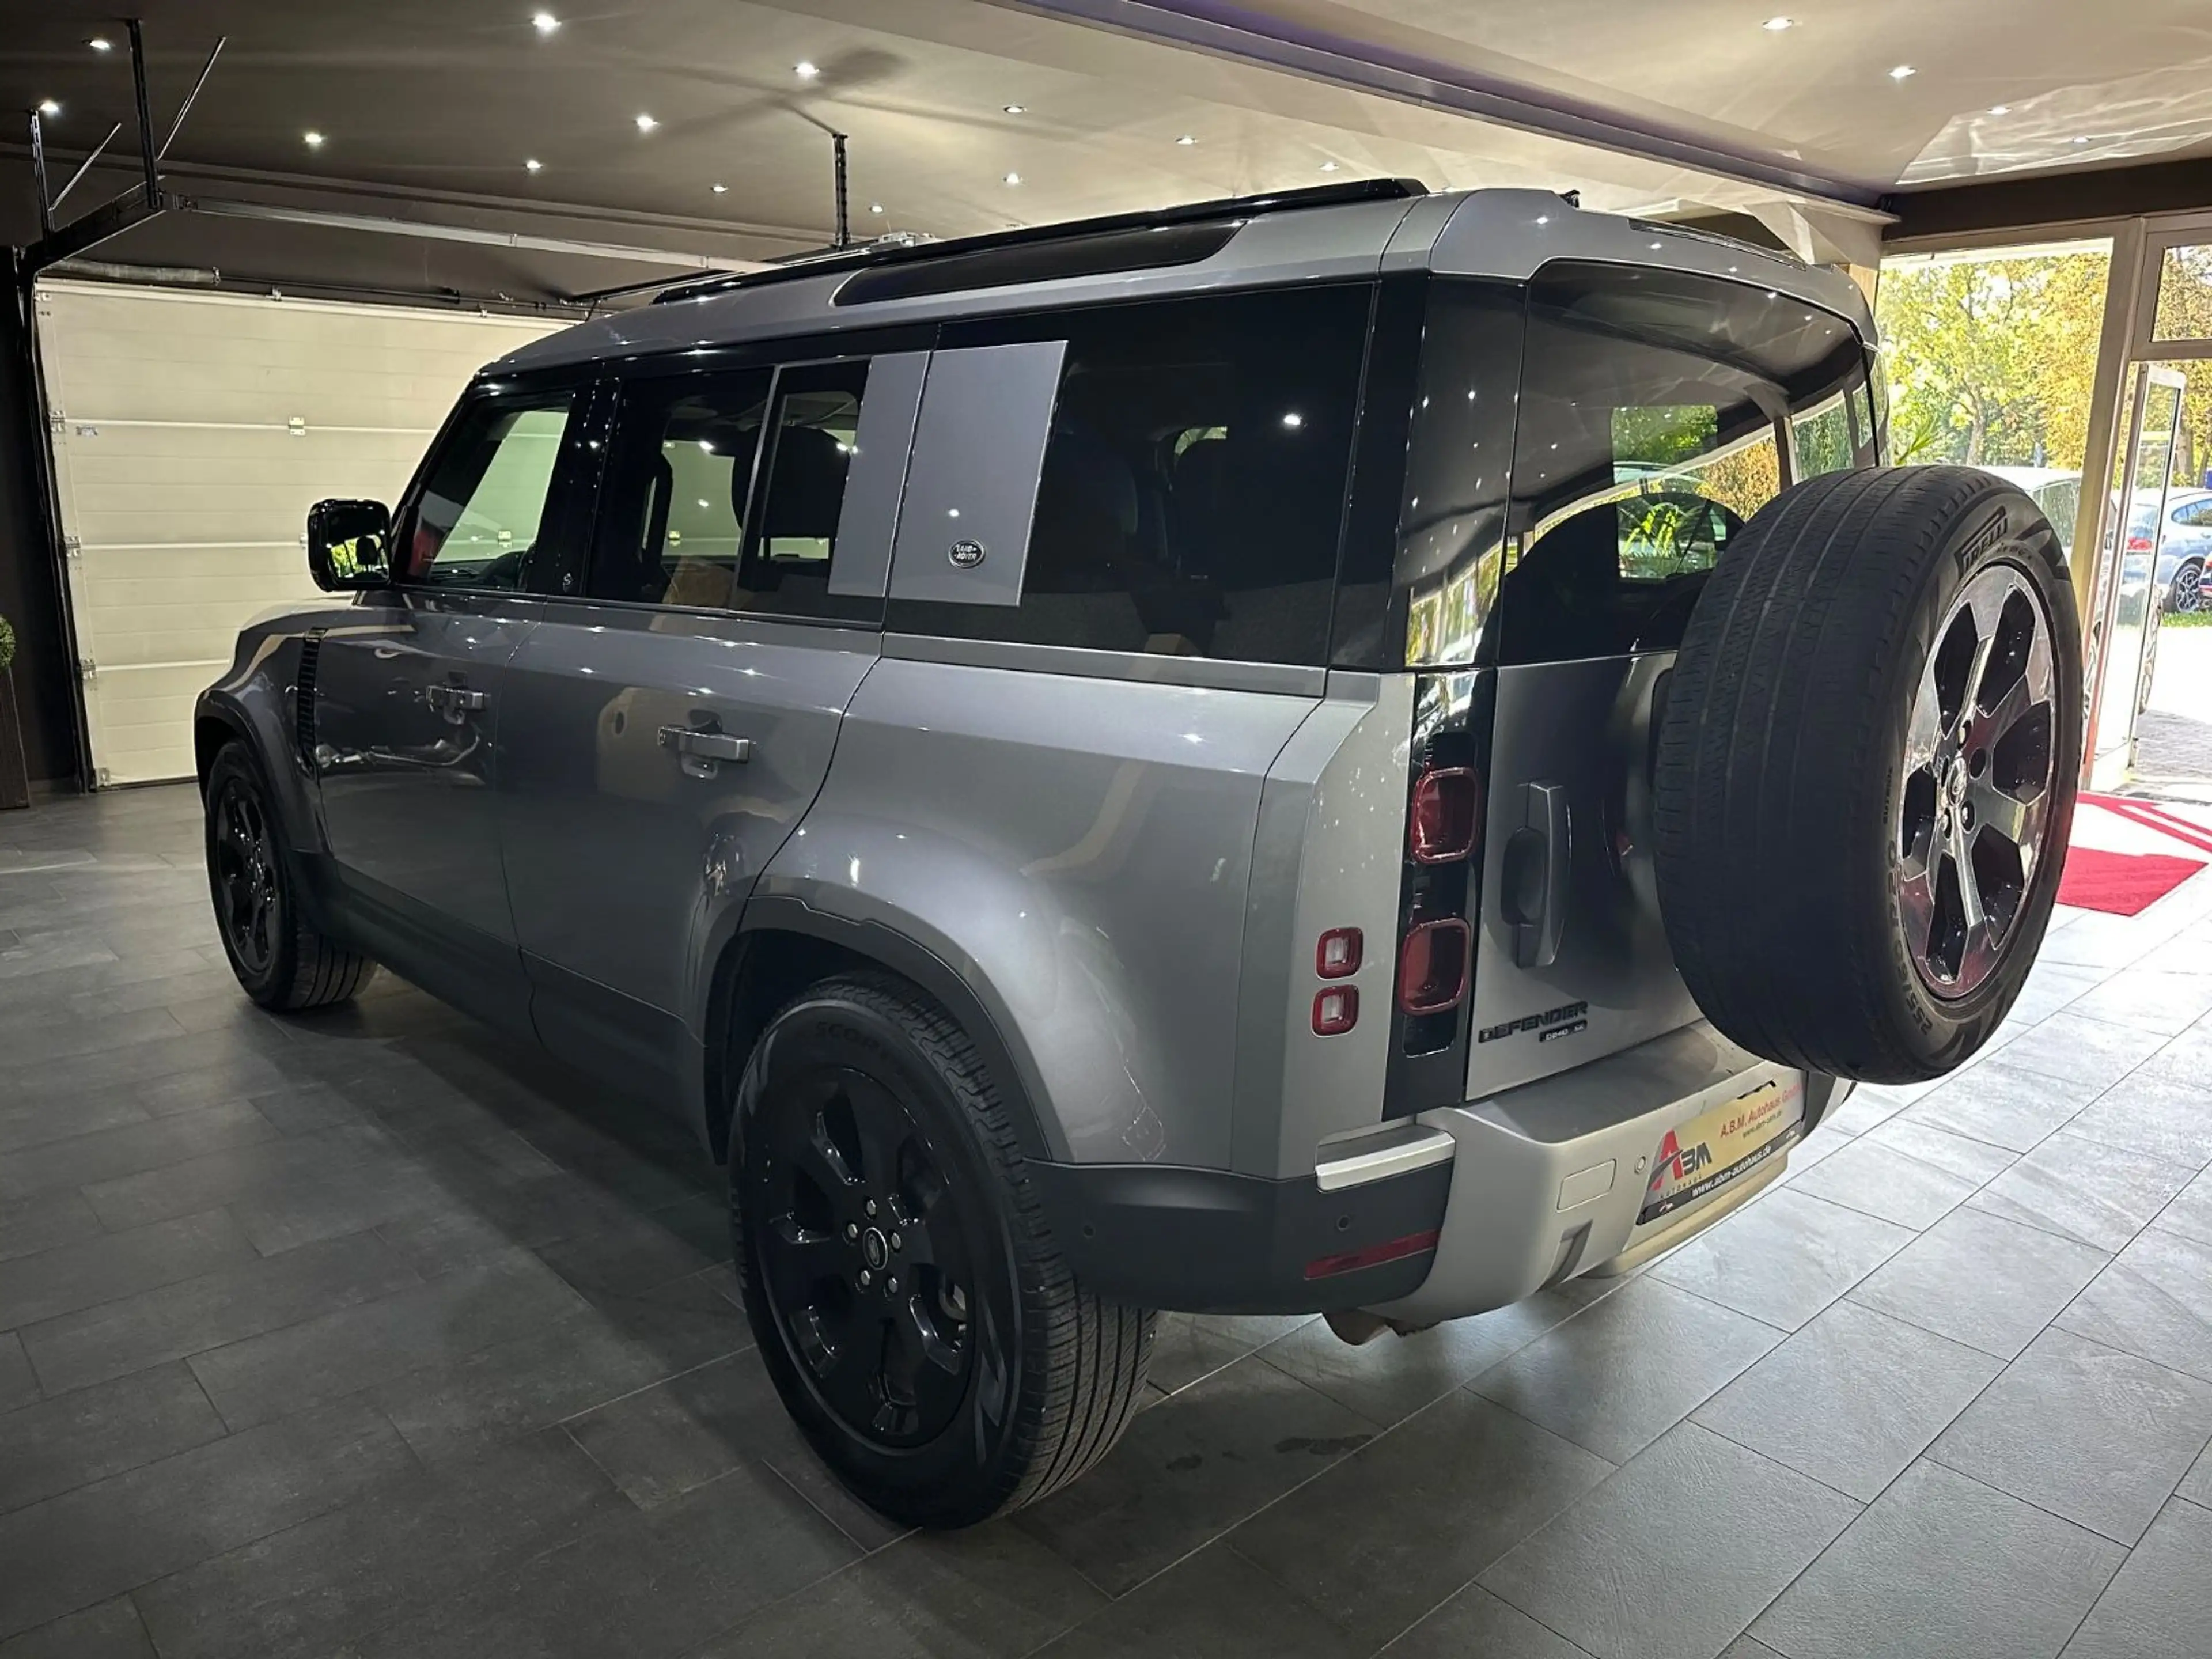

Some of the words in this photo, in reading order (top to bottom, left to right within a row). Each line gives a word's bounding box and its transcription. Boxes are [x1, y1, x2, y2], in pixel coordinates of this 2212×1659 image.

[1953, 505, 2008, 582] PIRELLI
[1478, 1001, 1588, 1043] DEFENDER
[1748, 1096, 1781, 1123] Autohaus
[1691, 1145, 1772, 1198] www.abm-autohaus.de
